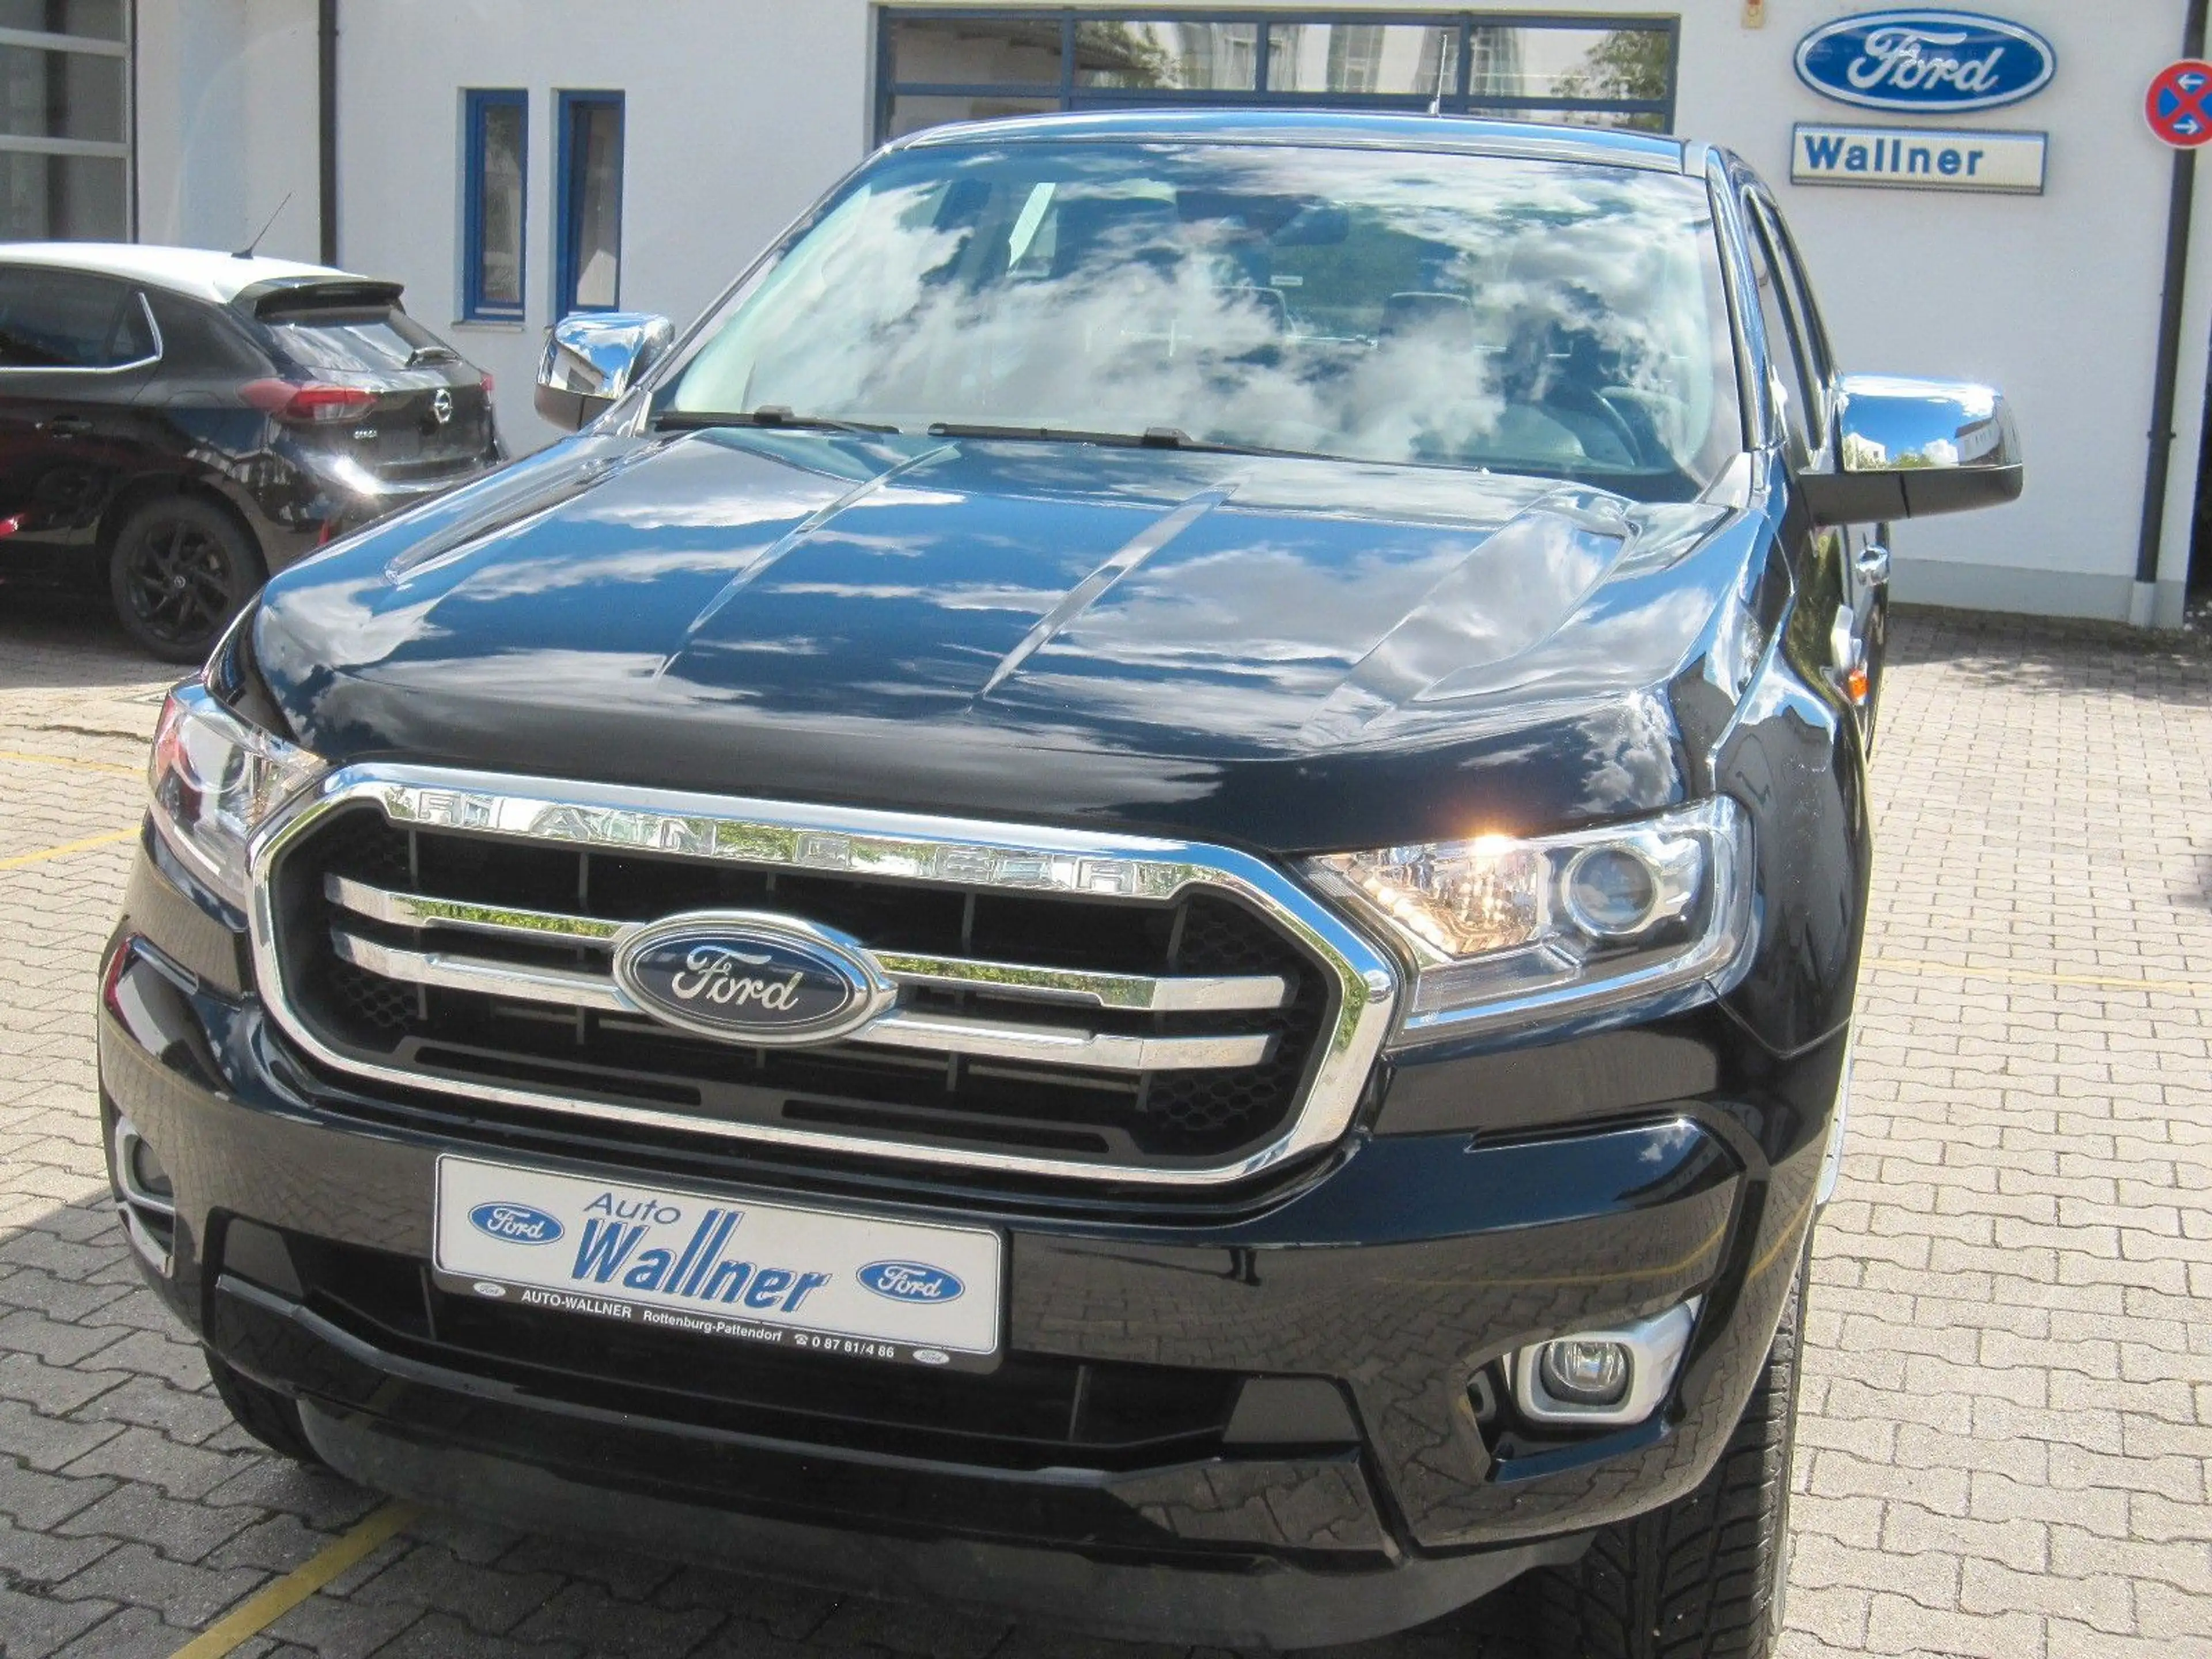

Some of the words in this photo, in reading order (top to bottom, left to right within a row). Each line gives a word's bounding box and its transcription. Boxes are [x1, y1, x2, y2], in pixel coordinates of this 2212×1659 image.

[1847, 26, 2005, 92] Ford
[1804, 135, 1983, 175] Wallner
[671, 945, 805, 1010] Ford
[487, 1208, 545, 1238] Ford
[583, 1192, 681, 1225] Auto
[571, 1208, 833, 1312] Wallner
[877, 1266, 943, 1297] Ford
[521, 1289, 632, 1319] AUTO-WALLNER
[643, 1310, 782, 1342] Rottenburg-Pattendorf
[812, 1336, 820, 1347] 0
[824, 1338, 841, 1350] 87
[844, 1341, 874, 1355] 81/4
[878, 1346, 895, 1358] 86
